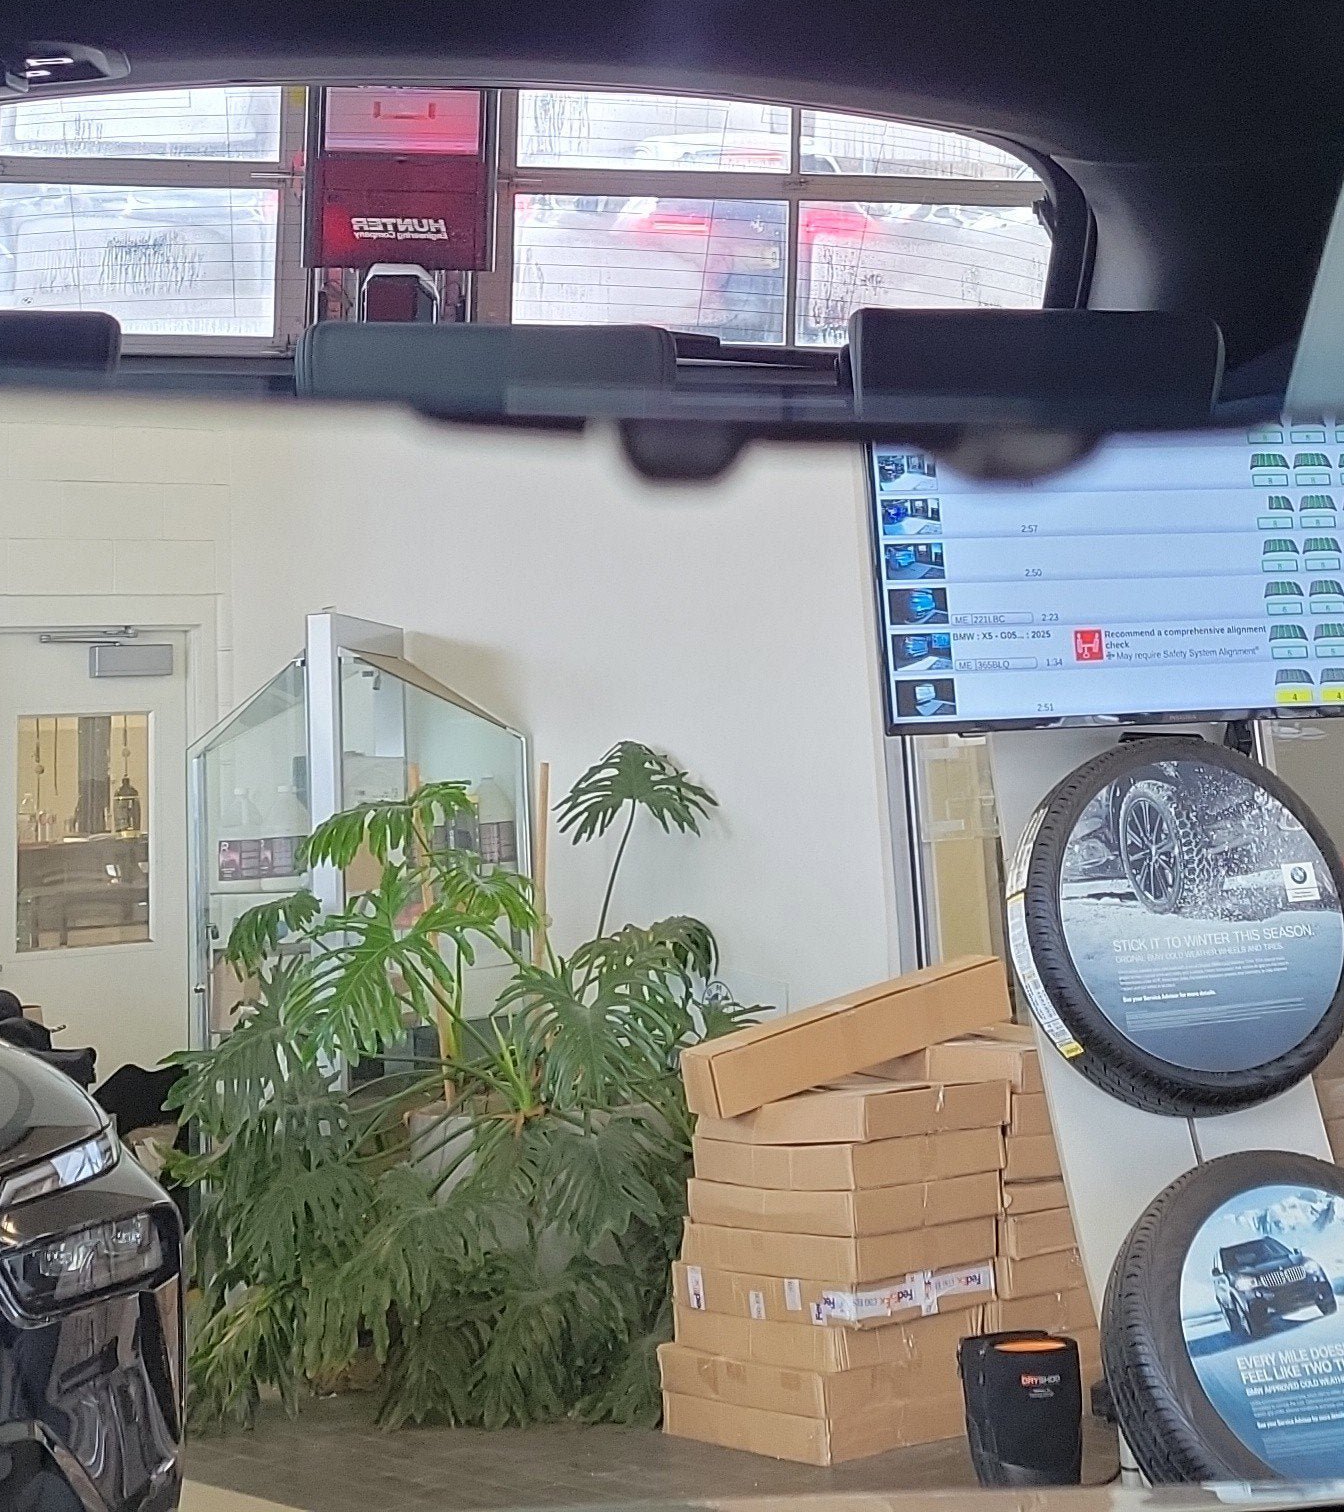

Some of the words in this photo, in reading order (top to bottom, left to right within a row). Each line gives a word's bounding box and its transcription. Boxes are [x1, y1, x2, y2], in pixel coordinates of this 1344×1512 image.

[953, 633, 975, 641] BMW
[981, 632, 993, 640] X5
[1031, 630, 1051, 638] 2025
[1105, 629, 1155, 638] Recommend
[1164, 627, 1225, 638] comprehensive
[1227, 625, 1266, 636] alignment
[1105, 641, 1130, 649] check
[1116, 652, 1132, 661] May
[1135, 650, 1161, 660] require
[1163, 649, 1187, 659] Safety
[1189, 648, 1217, 659] System
[1113, 938, 1148, 952] STICK
[1150, 937, 1160, 950] IT
[1164, 936, 1182, 950] TO
[1183, 932, 1231, 948] WINTER
[1234, 929, 1261, 944] THIS
[1263, 924, 1315, 940] SEASON.
[879, 1288, 914, 1308] FedEx
[1236, 1352, 1276, 1370] EVERY
[1278, 1349, 1310, 1365] MILE
[1240, 1369, 1274, 1385] FEEL
[1273, 1364, 1303, 1381] LIKE
[1301, 1360, 1333, 1376] TWO
[1245, 1387, 1264, 1397] BMW
[1264, 1382, 1300, 1395] APPROVED
[1299, 1379, 1319, 1389] COLD
